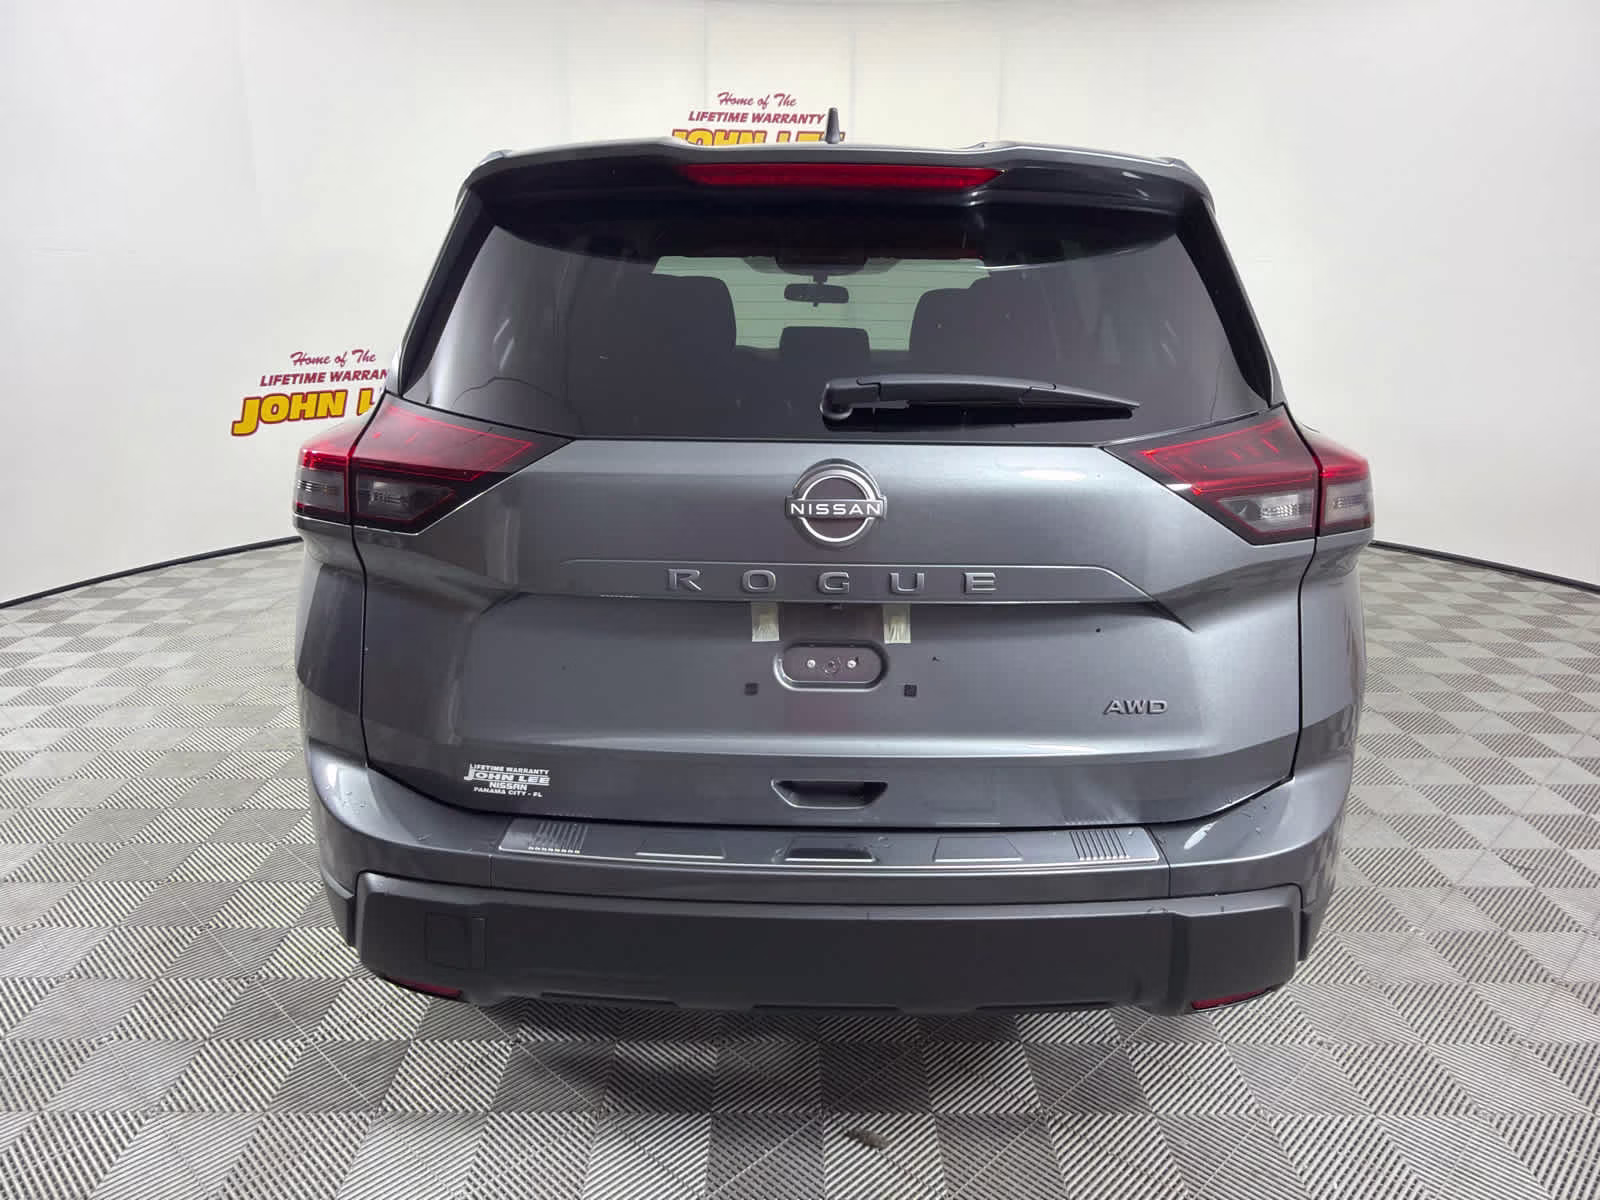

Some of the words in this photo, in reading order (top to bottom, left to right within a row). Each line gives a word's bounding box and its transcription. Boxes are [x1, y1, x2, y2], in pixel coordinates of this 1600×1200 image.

[717, 92, 754, 106] Home
[758, 97, 770, 109] of
[774, 93, 797, 107] The
[688, 111, 748, 122] LIFETIME
[751, 113, 826, 124] WARRANTY
[290, 351, 331, 366] Home
[334, 352, 349, 367] of
[351, 349, 377, 363] The
[260, 372, 325, 387] LIFETIME
[329, 368, 389, 383] WARRAN
[231, 389, 348, 436] JOHN
[790, 502, 882, 516] NISSAN
[667, 567, 998, 594] ROGUE
[1103, 699, 1168, 715] AWD
[464, 766, 514, 781] JOHN
[518, 775, 551, 784] LEE
[469, 763, 505, 772] LIFETIME
[506, 767, 550, 775] WARRANTY
[473, 786, 506, 795] PANAMA
[489, 781, 528, 791] NISSAN
